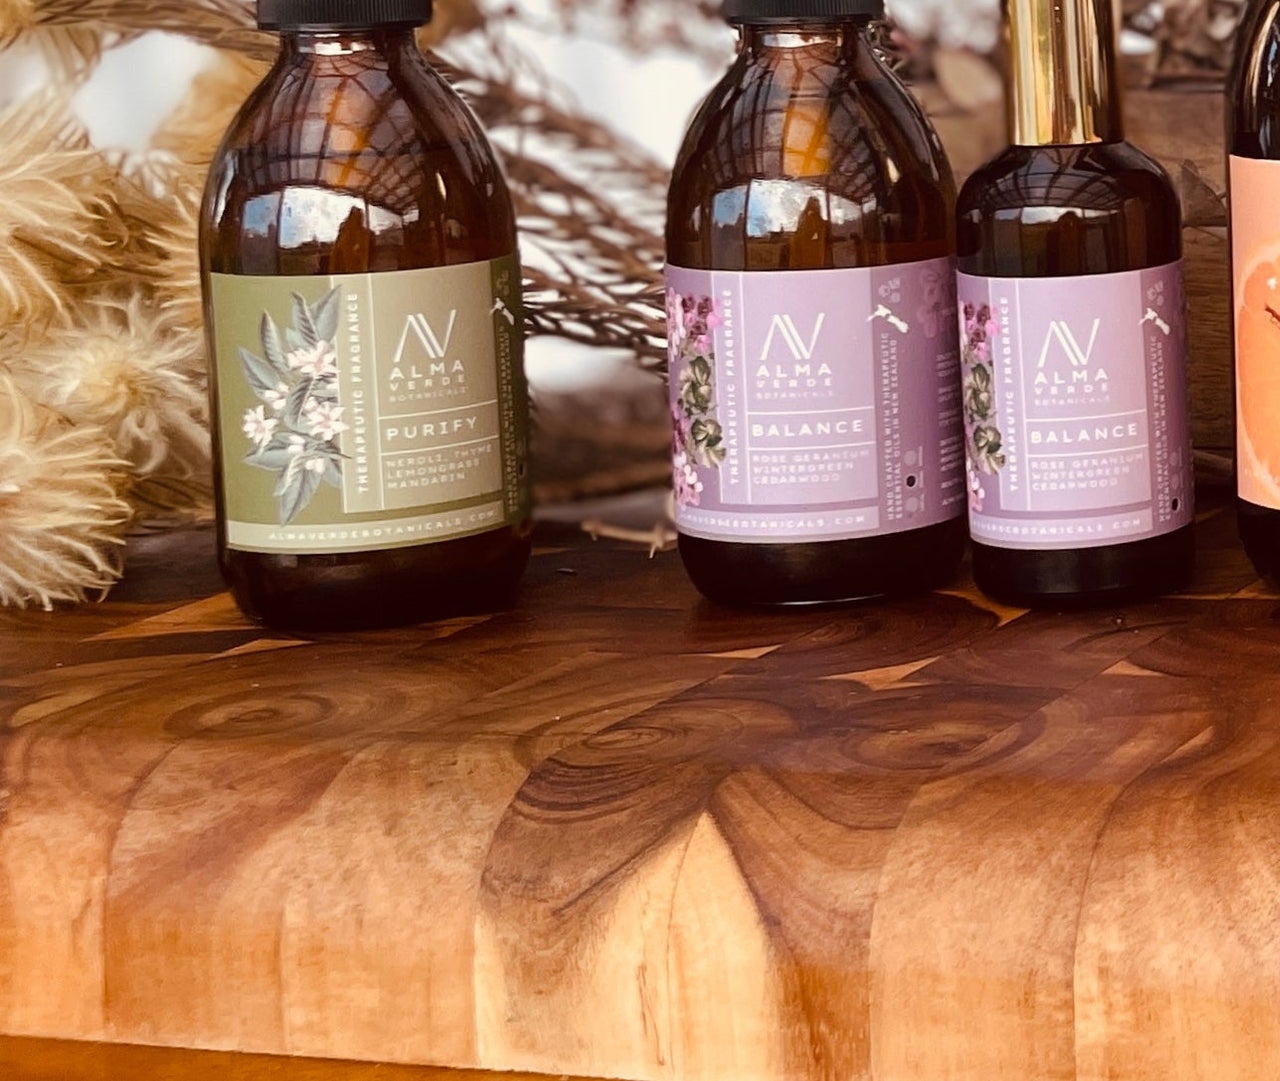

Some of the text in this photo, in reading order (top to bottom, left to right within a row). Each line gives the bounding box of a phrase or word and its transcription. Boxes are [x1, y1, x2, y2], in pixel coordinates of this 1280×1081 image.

[390, 360, 464, 380] ALMA
[756, 363, 832, 378] ALMA
[1034, 368, 1108, 384] ALMA
[390, 374, 464, 391] VERDE
[723, 290, 739, 484] THERAPEUTIC FRAGRANCE
[756, 378, 832, 388] VERDE
[1034, 382, 1108, 395] VERDE
[348, 294, 369, 492] THERAPEUTIC FRAGRANCE
[1000, 297, 1018, 492] THERAPEUTIC FRAGRANCE
[386, 416, 476, 440] PURIFY
[752, 420, 862, 437] BALANCE
[1030, 423, 1137, 444] BALANCE
[388, 458, 480, 478] LEMONGRASS
[1032, 462, 1065, 470] ROSE
[388, 472, 465, 488] MANDARIN
